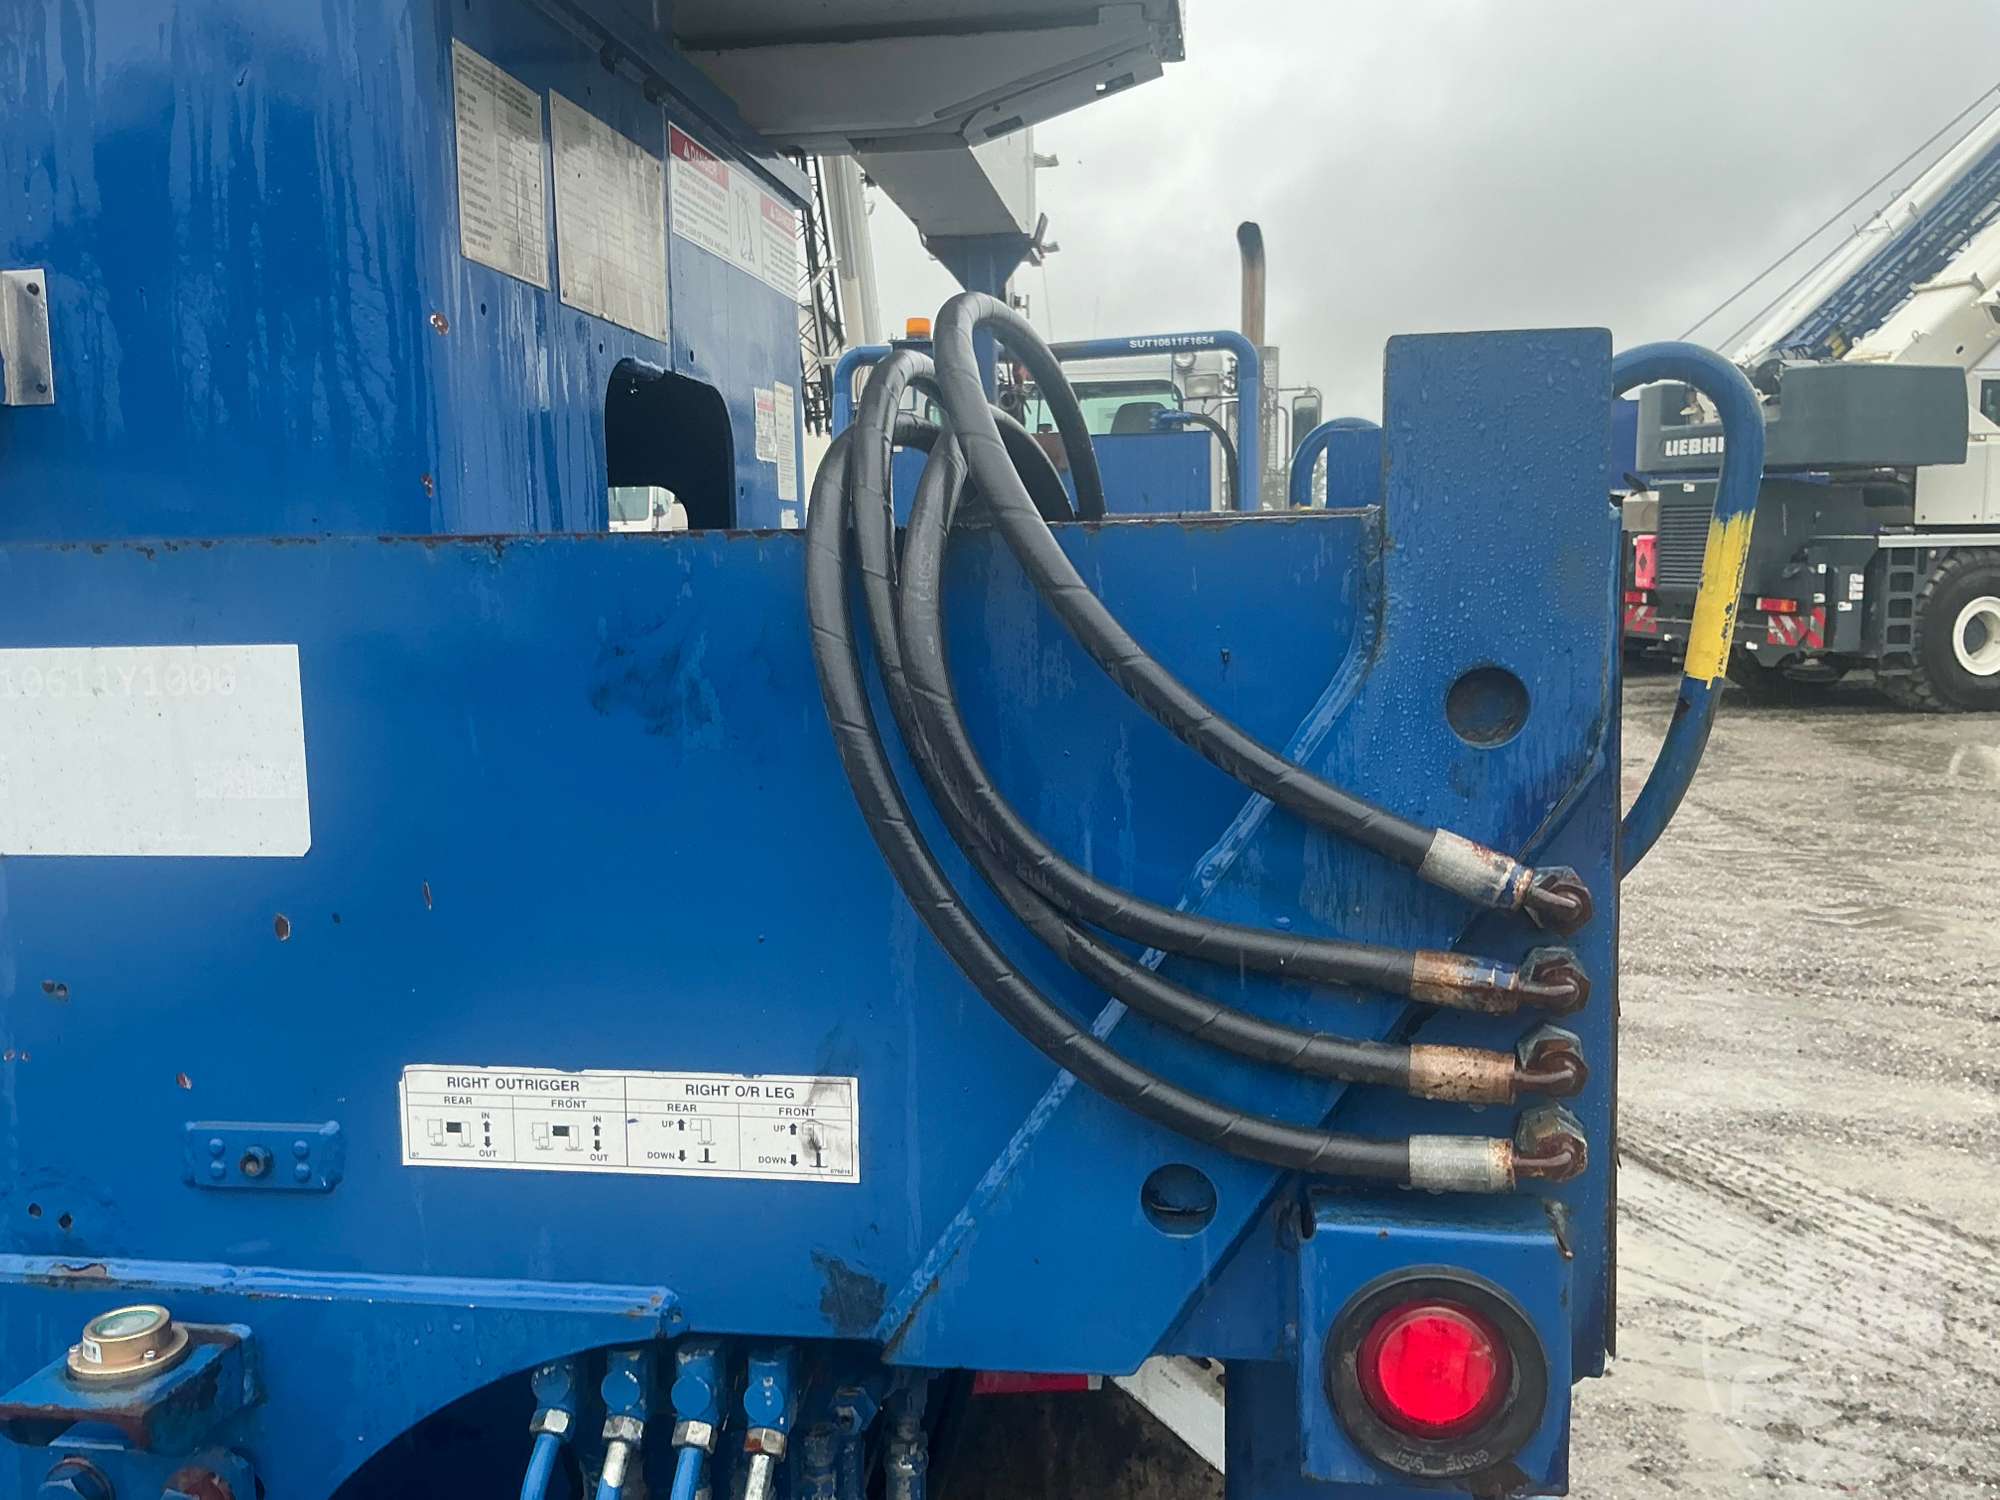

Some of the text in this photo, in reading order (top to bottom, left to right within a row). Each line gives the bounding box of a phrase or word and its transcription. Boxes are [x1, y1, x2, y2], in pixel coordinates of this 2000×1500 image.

[447, 1076, 580, 1092] RIGHT OUTRIGGER
[685, 1084, 795, 1099] RIGHT O/R LEG
[444, 1095, 473, 1105] REAR
[551, 1099, 587, 1109] FRONT
[667, 1103, 697, 1113] REAR
[778, 1107, 816, 1117] FRONT
[662, 1120, 674, 1128] UP
[773, 1125, 786, 1133] UP
[479, 1150, 497, 1158] OUT
[590, 1154, 609, 1162] OUT
[647, 1151, 675, 1160] DOWN
[758, 1156, 787, 1164] DOWN
